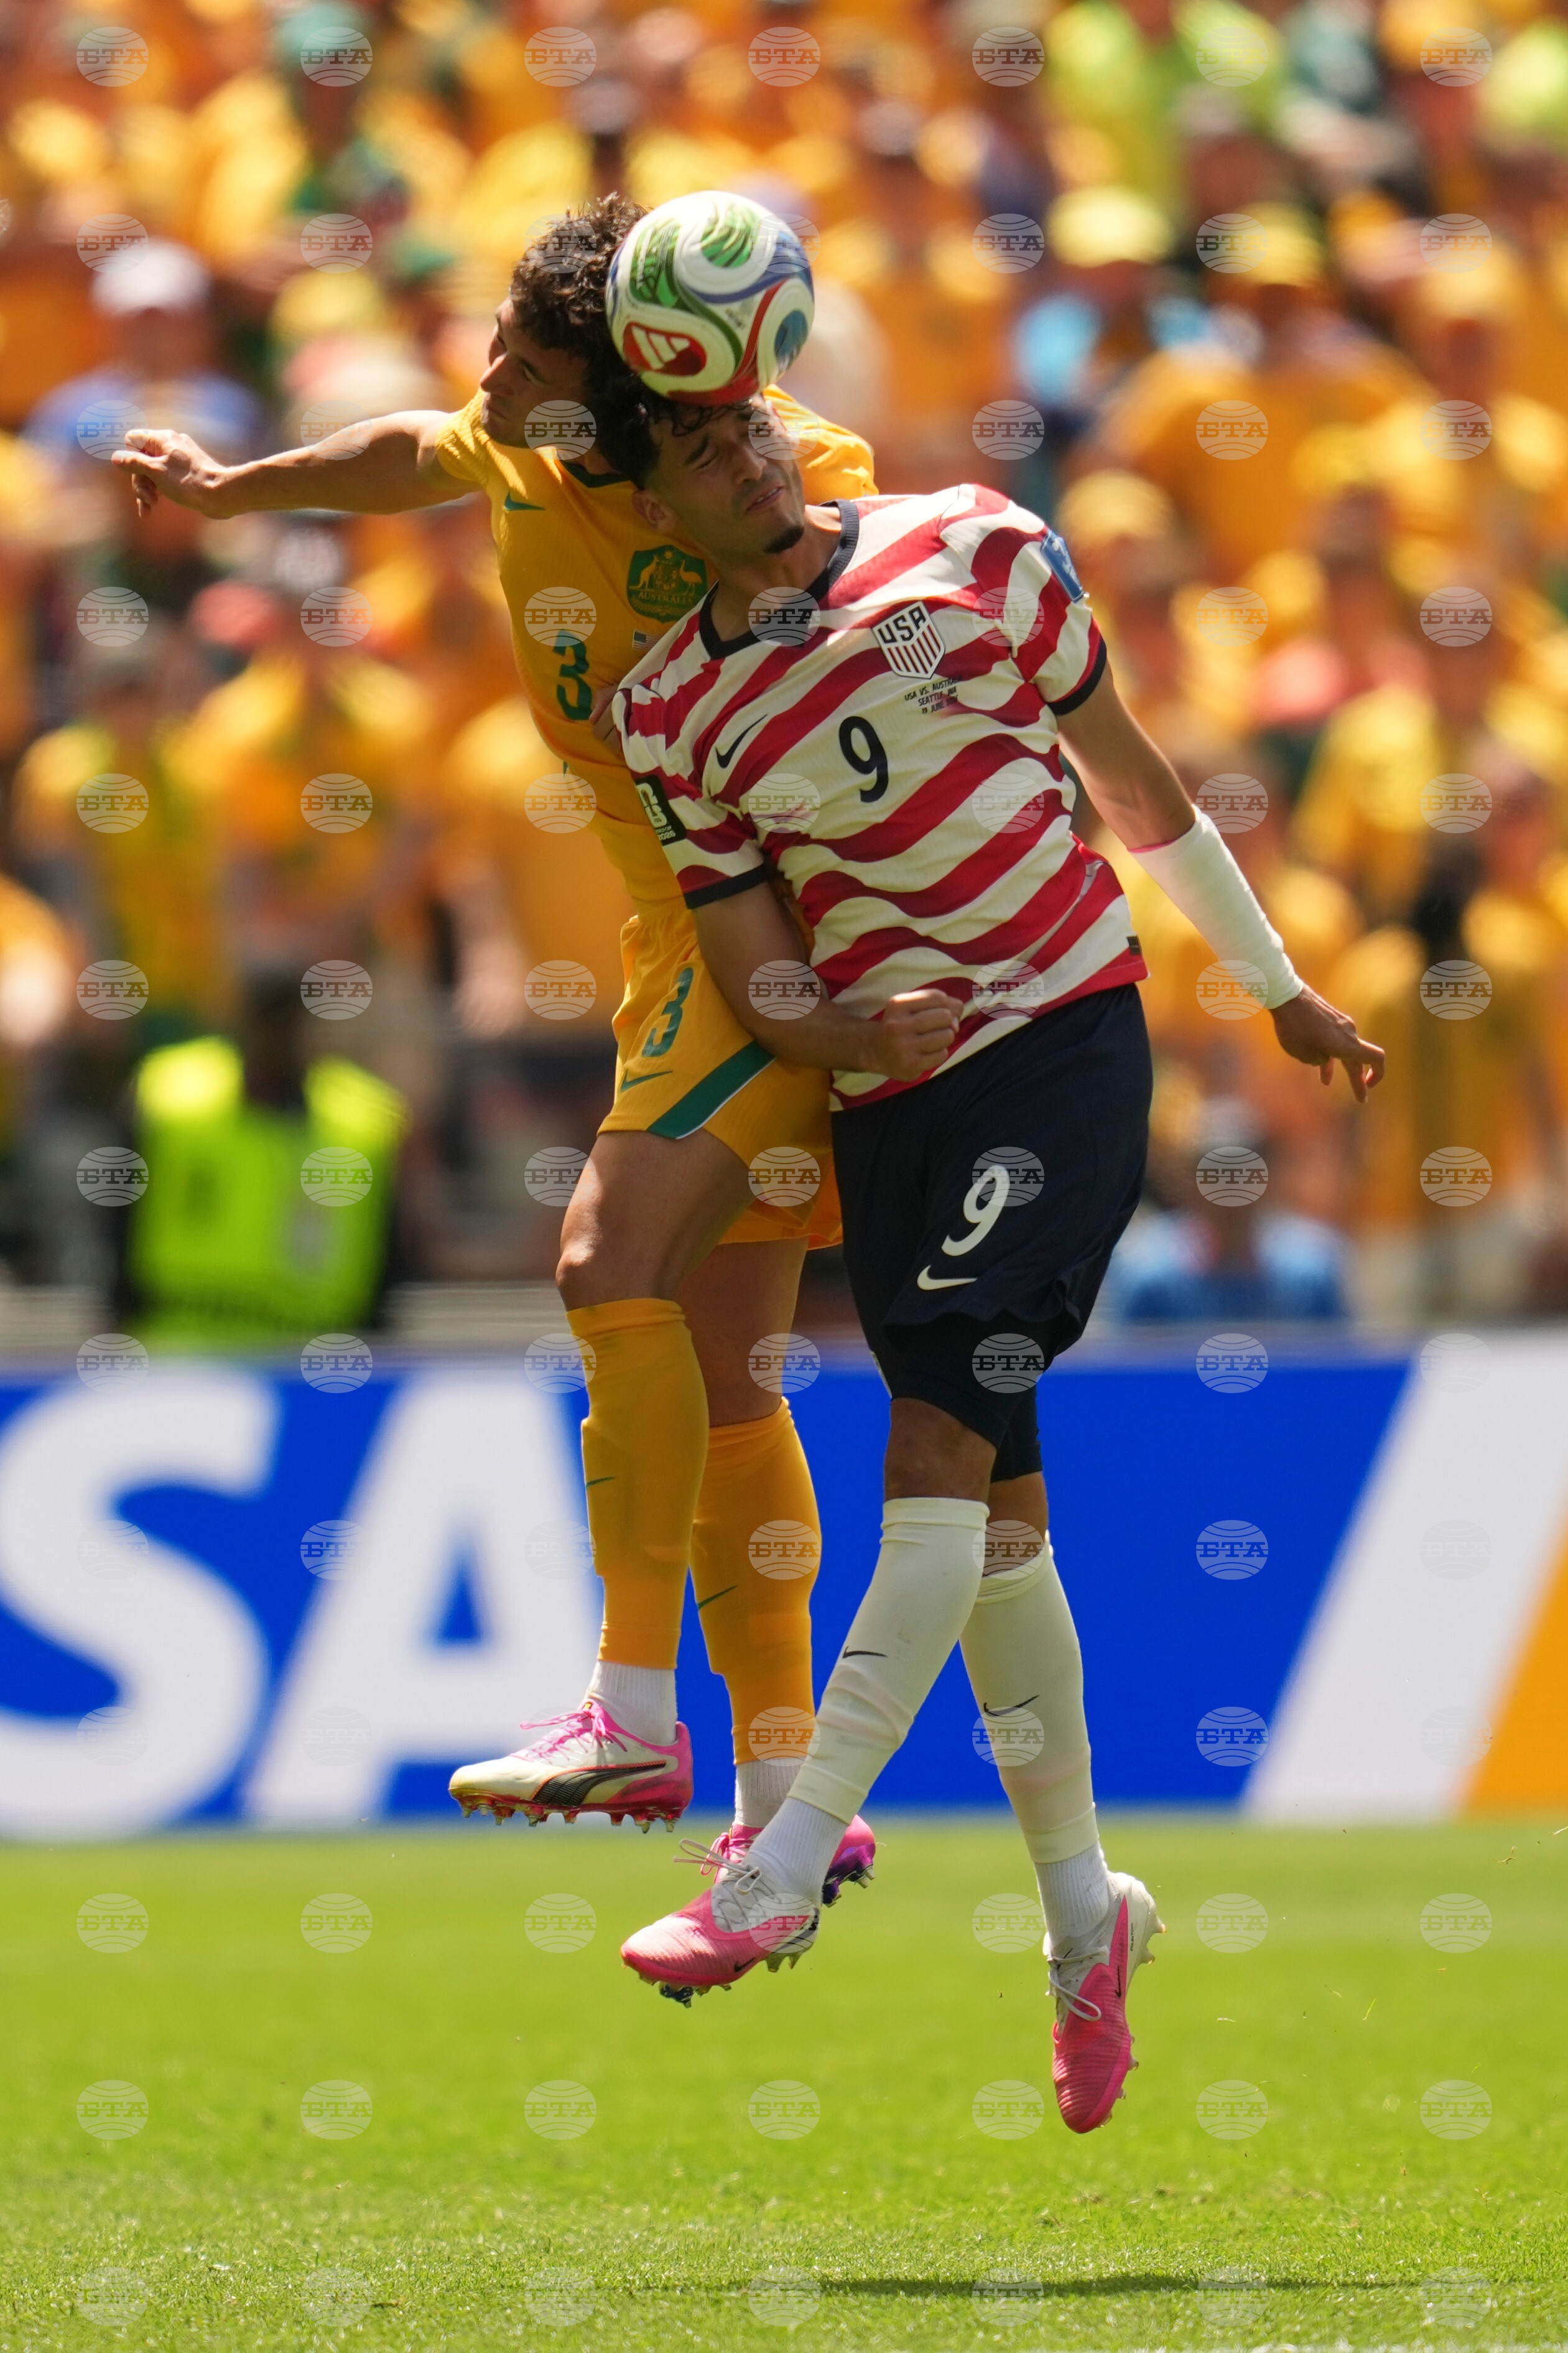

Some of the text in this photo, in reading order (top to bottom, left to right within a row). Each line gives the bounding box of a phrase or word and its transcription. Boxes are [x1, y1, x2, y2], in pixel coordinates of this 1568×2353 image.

[878, 606, 927, 644] USA
[553, 629, 593, 720] 3
[904, 691, 917, 701] USA
[838, 715, 889, 803] 9
[642, 967, 694, 1058] 3
[941, 1165, 1010, 1257] 9
[0, 1361, 628, 1835] SA
